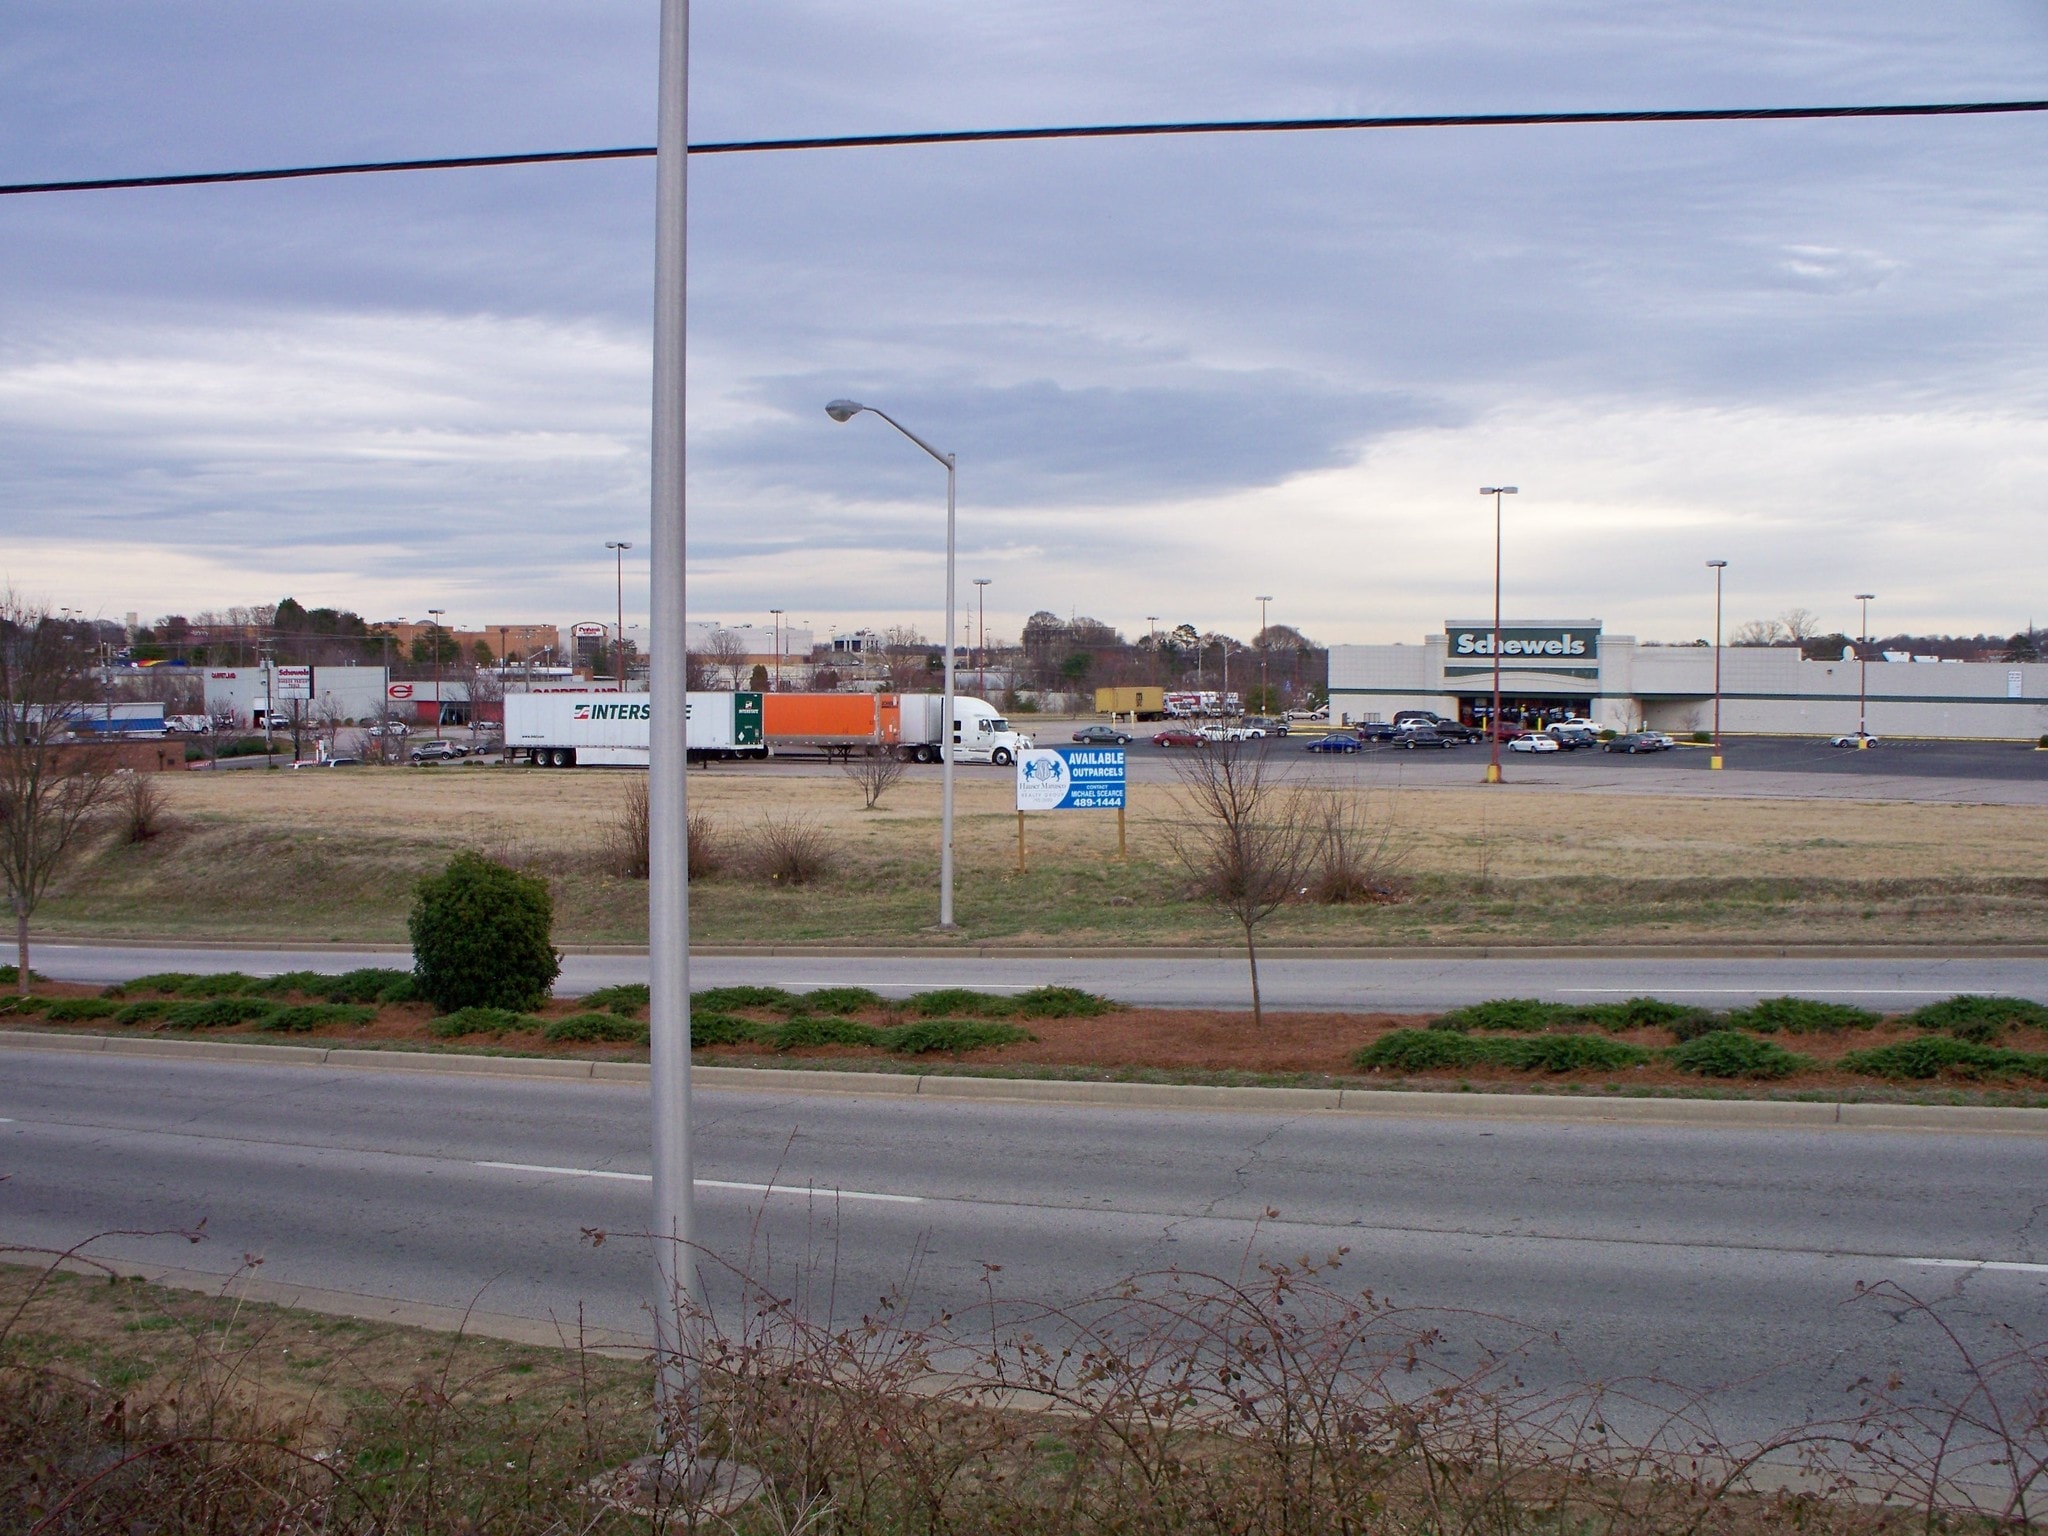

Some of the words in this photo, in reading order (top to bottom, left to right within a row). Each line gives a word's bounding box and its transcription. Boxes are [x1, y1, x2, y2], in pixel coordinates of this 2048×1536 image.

[1456, 633, 1585, 656] Schewels
[591, 704, 692, 720] INTERSE
[1069, 752, 1124, 765] AVAILABLE
[1072, 767, 1123, 777] OUTPARCELS
[1097, 789, 1123, 797] SCEARCE
[1073, 797, 1122, 808] 489-1444
